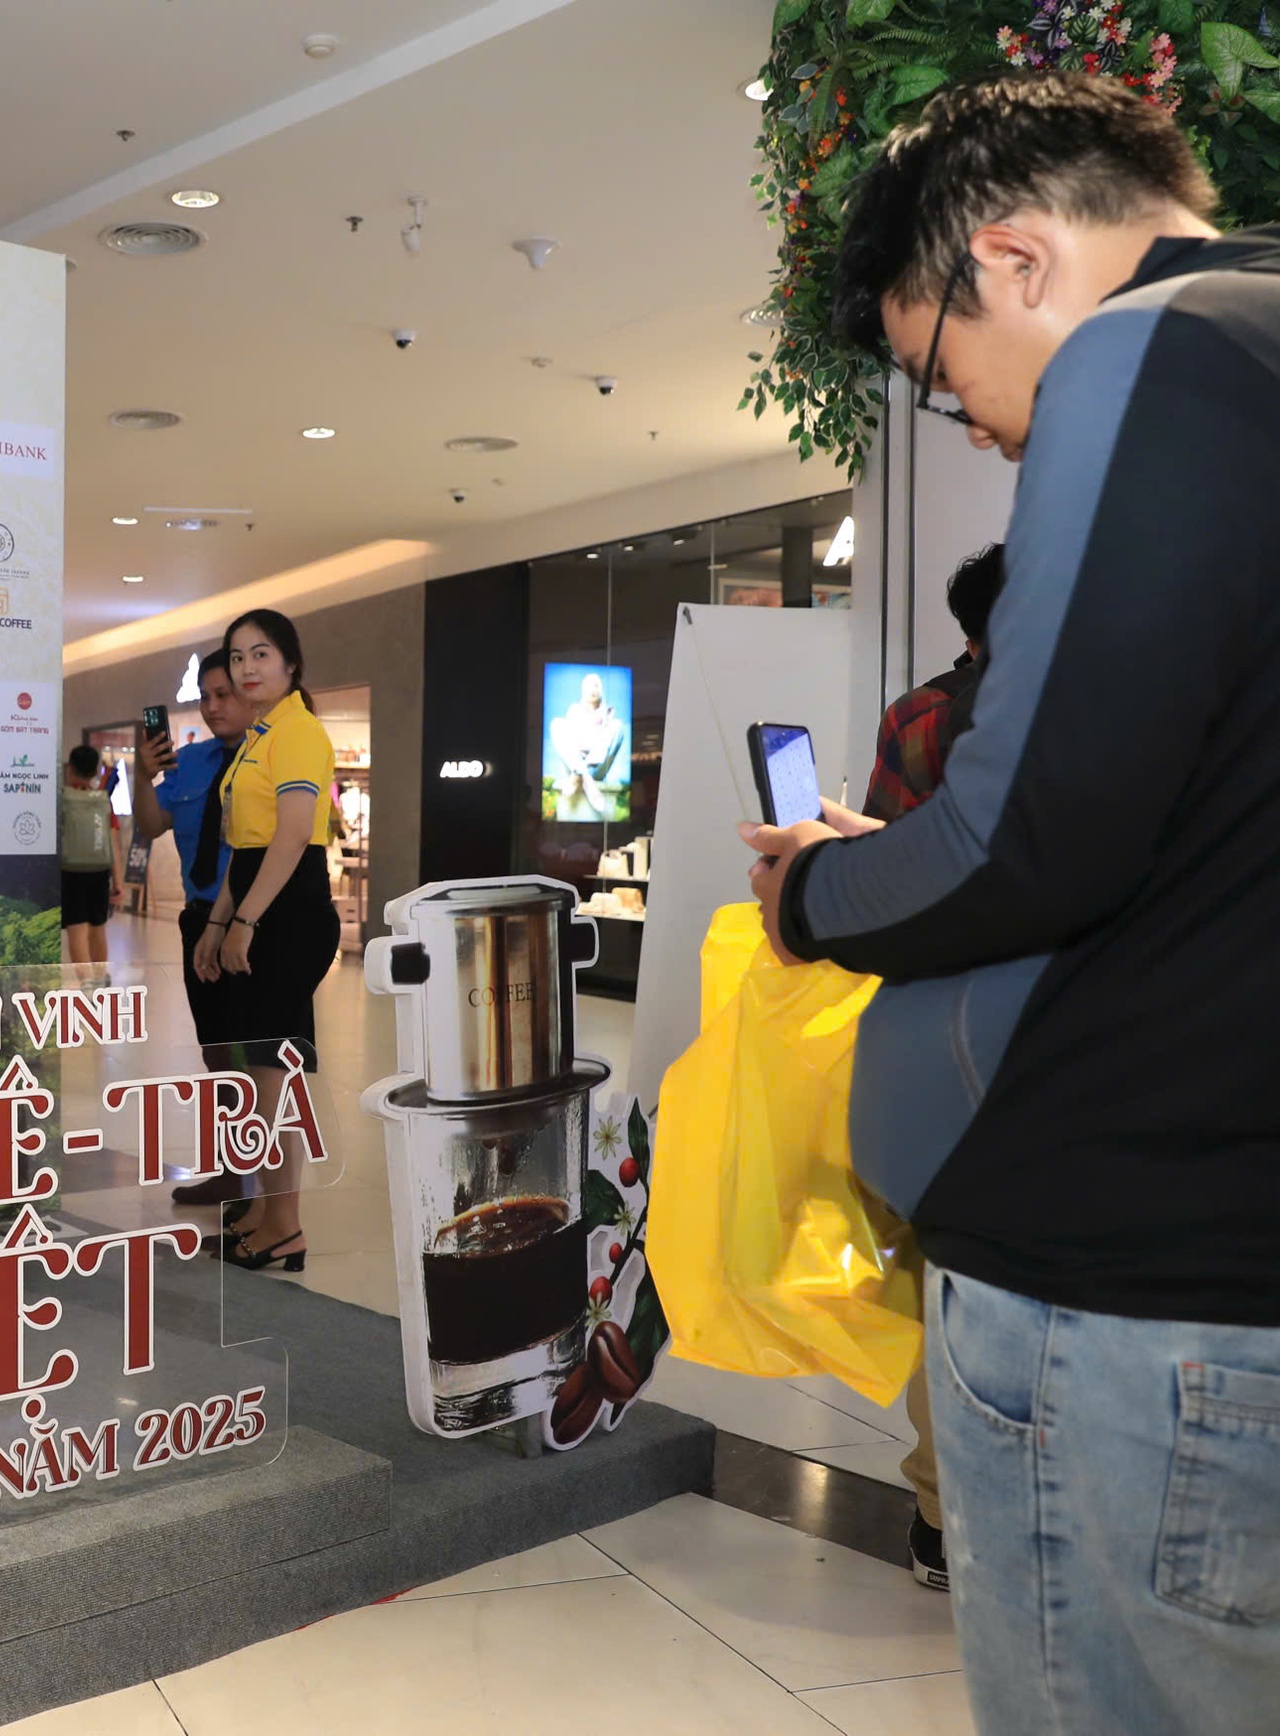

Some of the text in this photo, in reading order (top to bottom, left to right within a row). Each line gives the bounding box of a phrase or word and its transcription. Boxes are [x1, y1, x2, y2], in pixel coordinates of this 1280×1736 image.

[0, 618, 32, 630] COFFEE
[468, 982, 535, 1008] COFEE
[13, 986, 148, 1049] VINH
[134, 1386, 266, 1473] 2025
